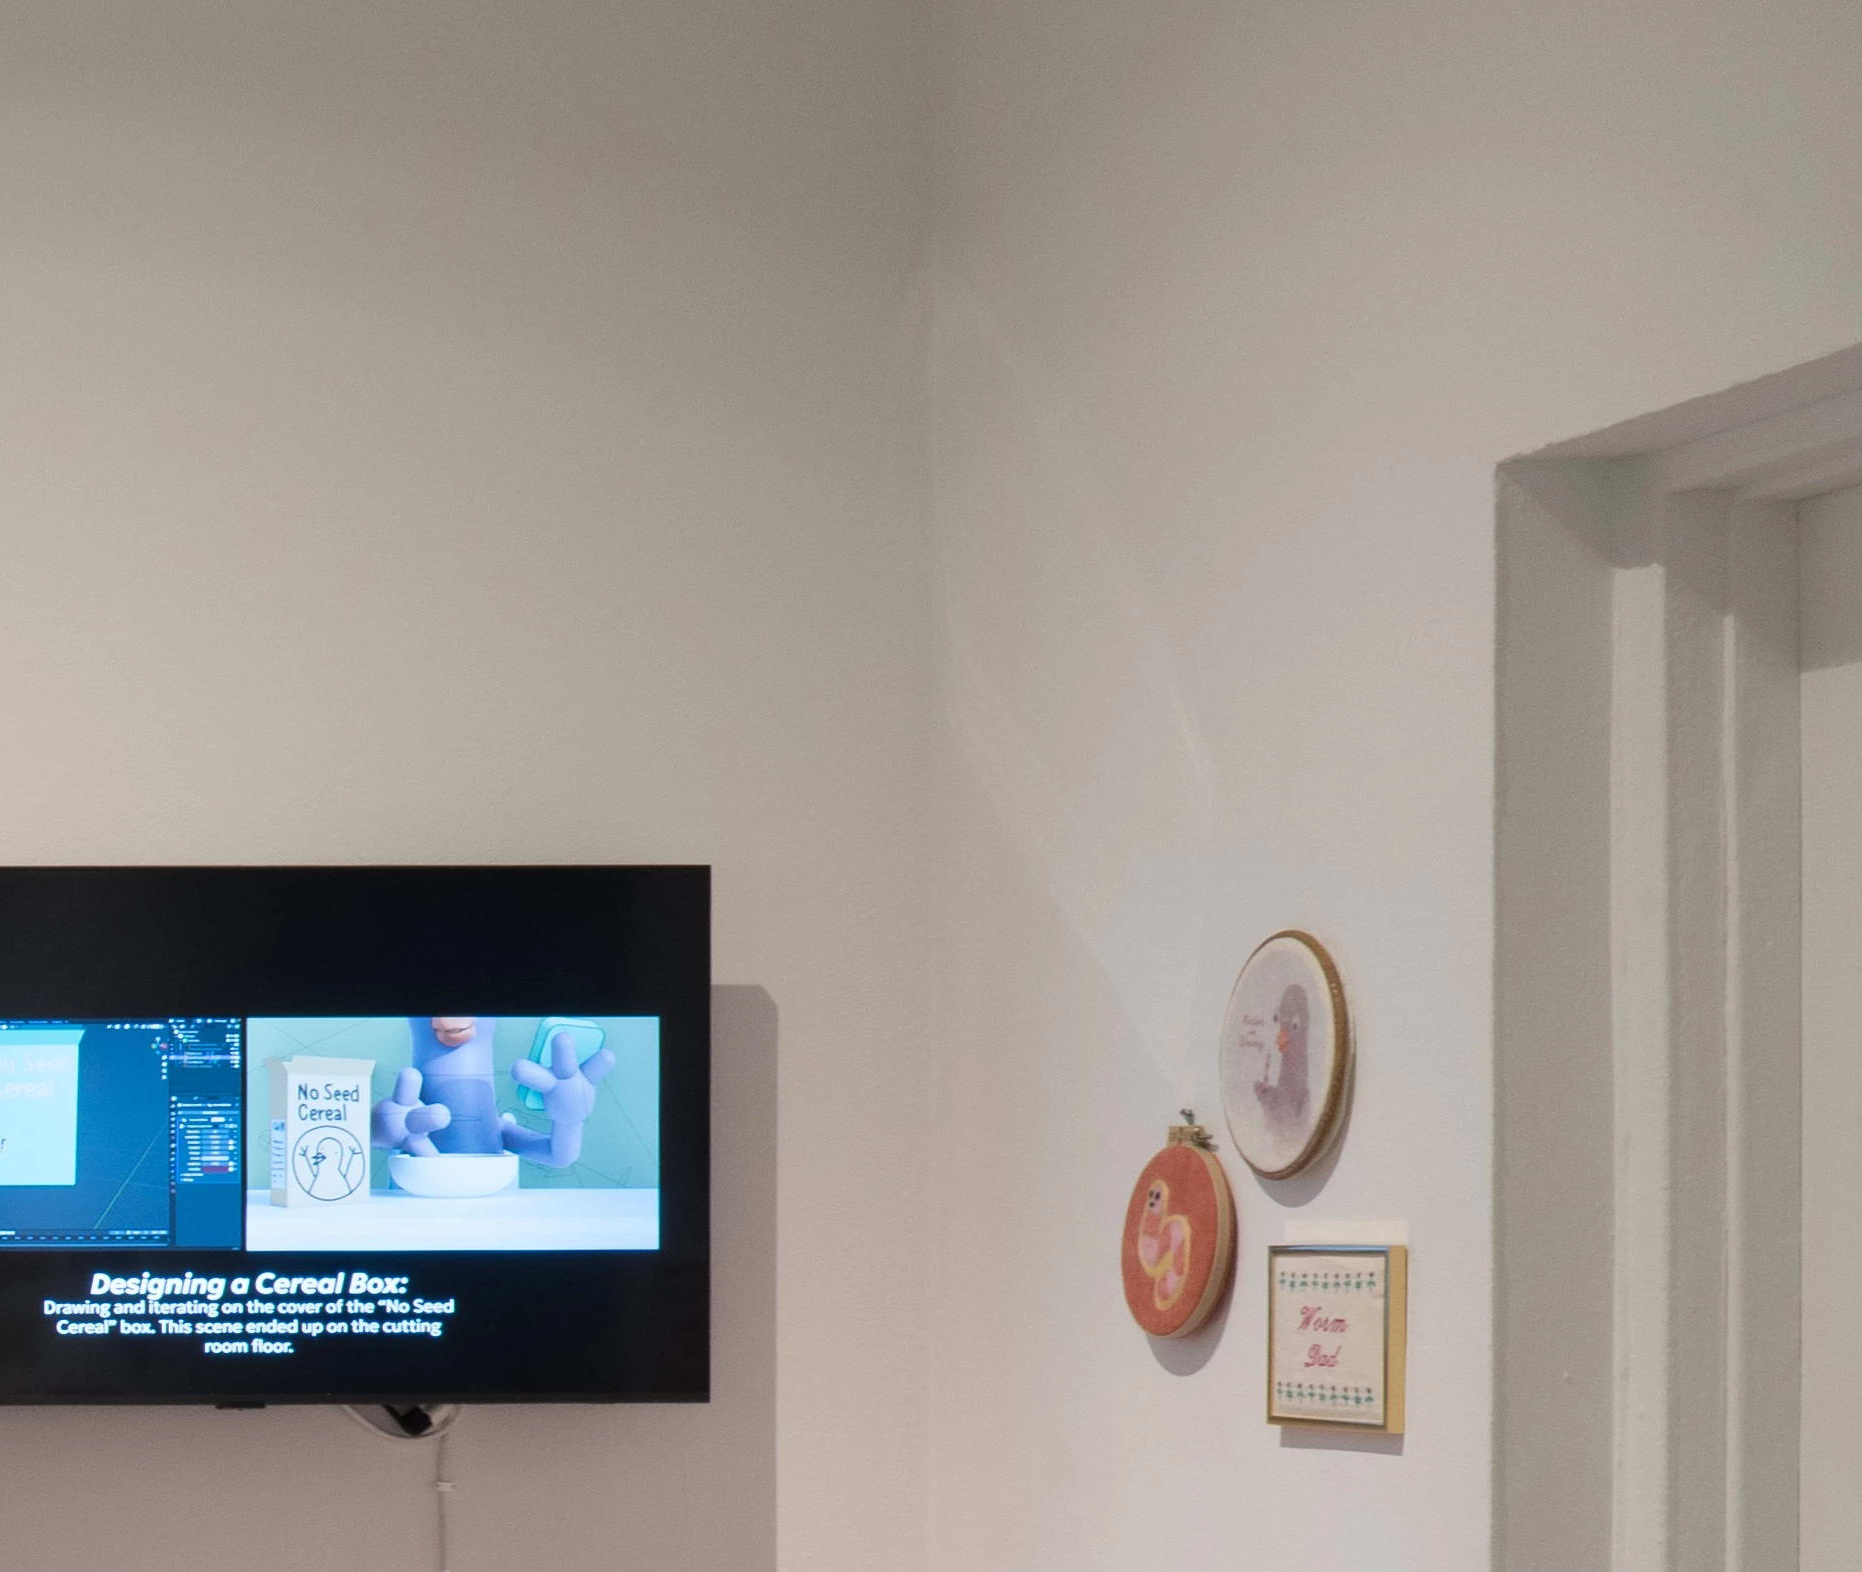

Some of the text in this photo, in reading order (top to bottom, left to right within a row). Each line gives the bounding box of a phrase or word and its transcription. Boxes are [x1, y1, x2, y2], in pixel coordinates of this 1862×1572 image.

[298, 1083, 359, 1103] No Seed
[298, 1103, 347, 1121] Cereal
[90, 1271, 409, 1300] Designing a Cereal Box:
[43, 1300, 111, 1318] Drawing
[113, 1300, 145, 1315] and
[148, 1300, 219, 1318] iterating
[221, 1302, 244, 1314] on
[246, 1299, 275, 1314] the
[277, 1302, 323, 1314] cover
[325, 1299, 345, 1314] of
[346, 1299, 375, 1314] the
[413, 1299, 455, 1314] Seed
[120, 1319, 156, 1334] box.
[158, 1319, 193, 1334] This
[194, 1321, 243, 1334] scene
[245, 1319, 299, 1334] ended
[301, 1321, 324, 1337] up
[326, 1321, 349, 1334] on
[350, 1319, 380, 1334] the
[382, 1318, 443, 1337] cutting
[1298, 1305, 1347, 1332] Worm
[204, 1338, 295, 1354] room floor.
[1304, 1345, 1342, 1369] Dad
